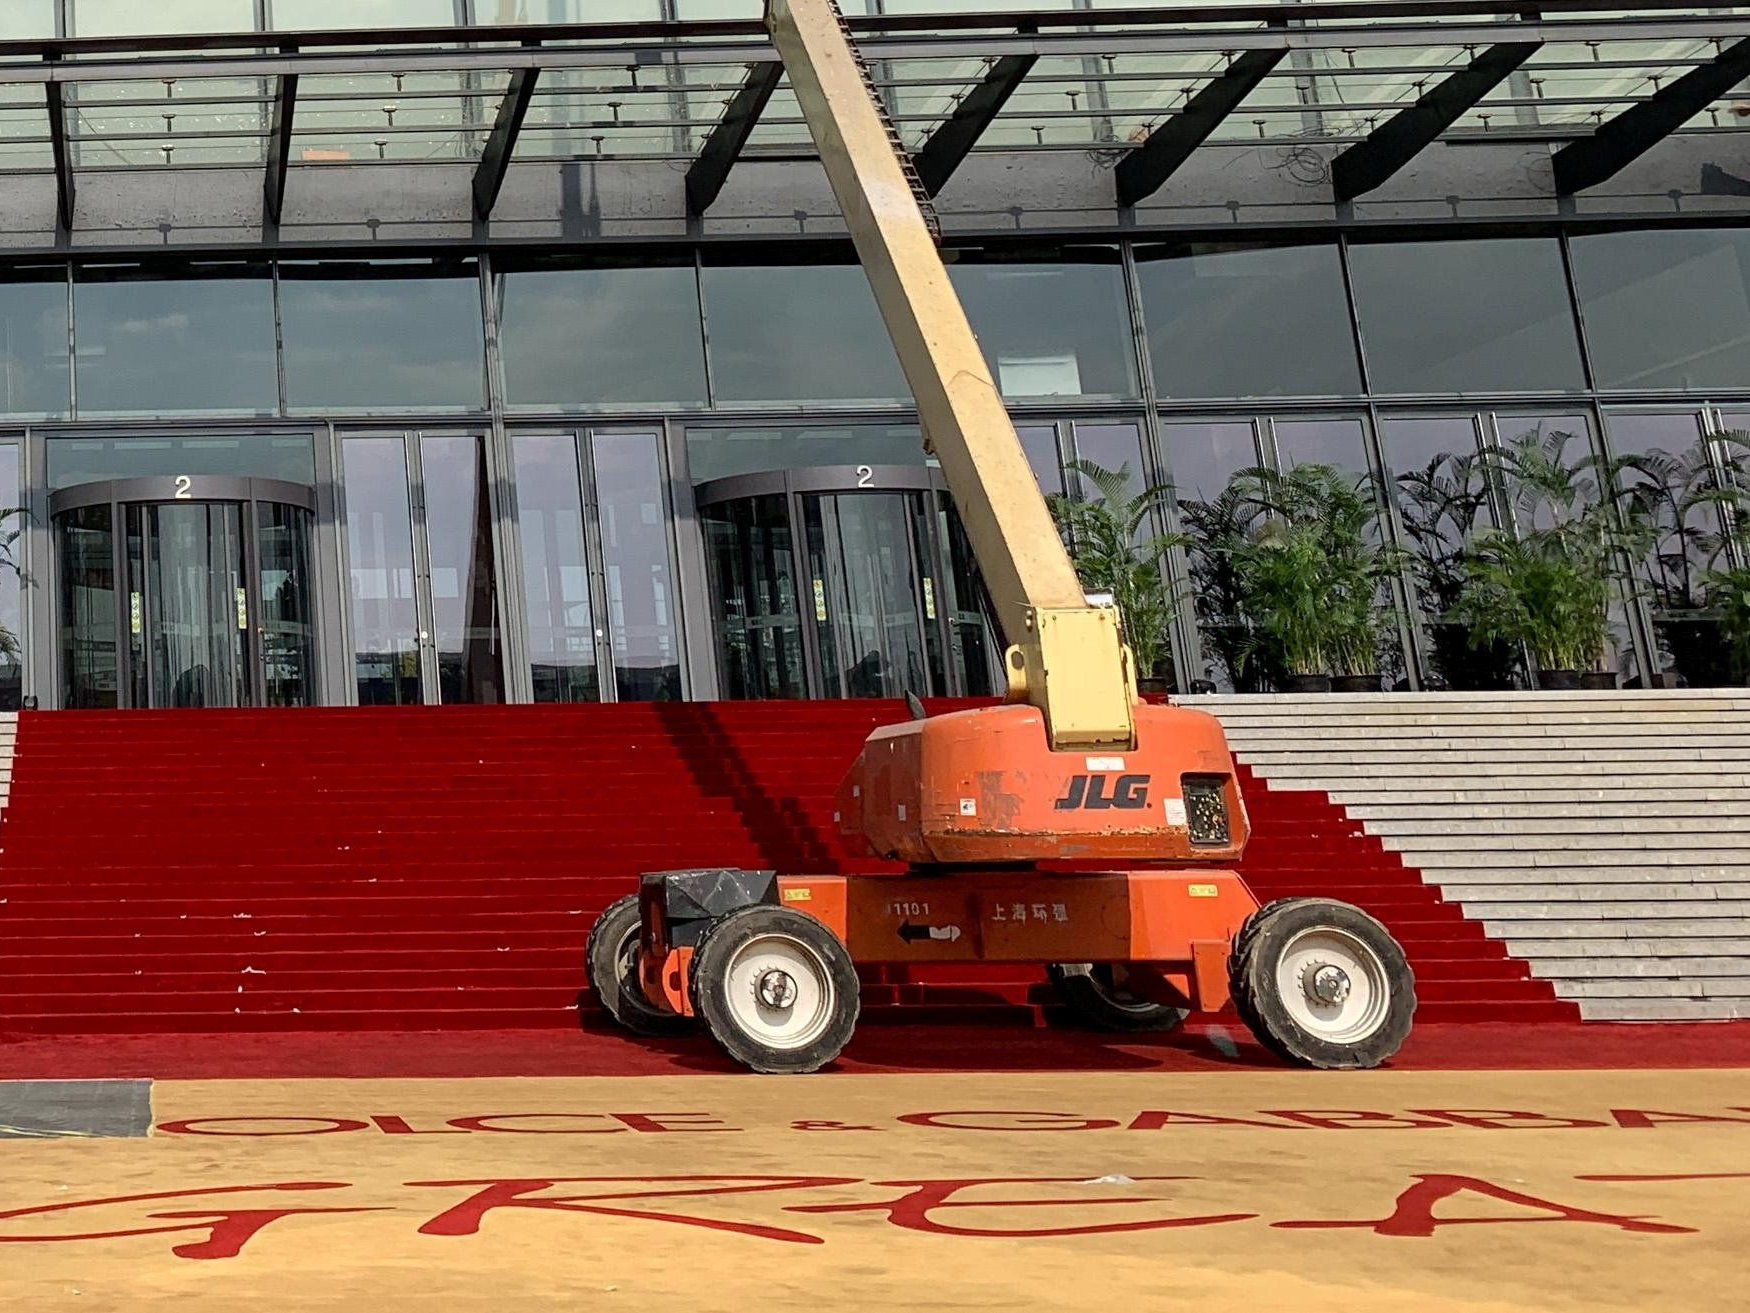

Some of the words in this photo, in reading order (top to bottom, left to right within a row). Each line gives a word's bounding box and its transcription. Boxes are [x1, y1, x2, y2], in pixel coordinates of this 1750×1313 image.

[175, 475, 192, 499] 2
[856, 465, 874, 488] 2
[1054, 774, 1151, 810] JLG
[790, 1119, 883, 1131] &
[897, 1105, 1750, 1131] GABBA
